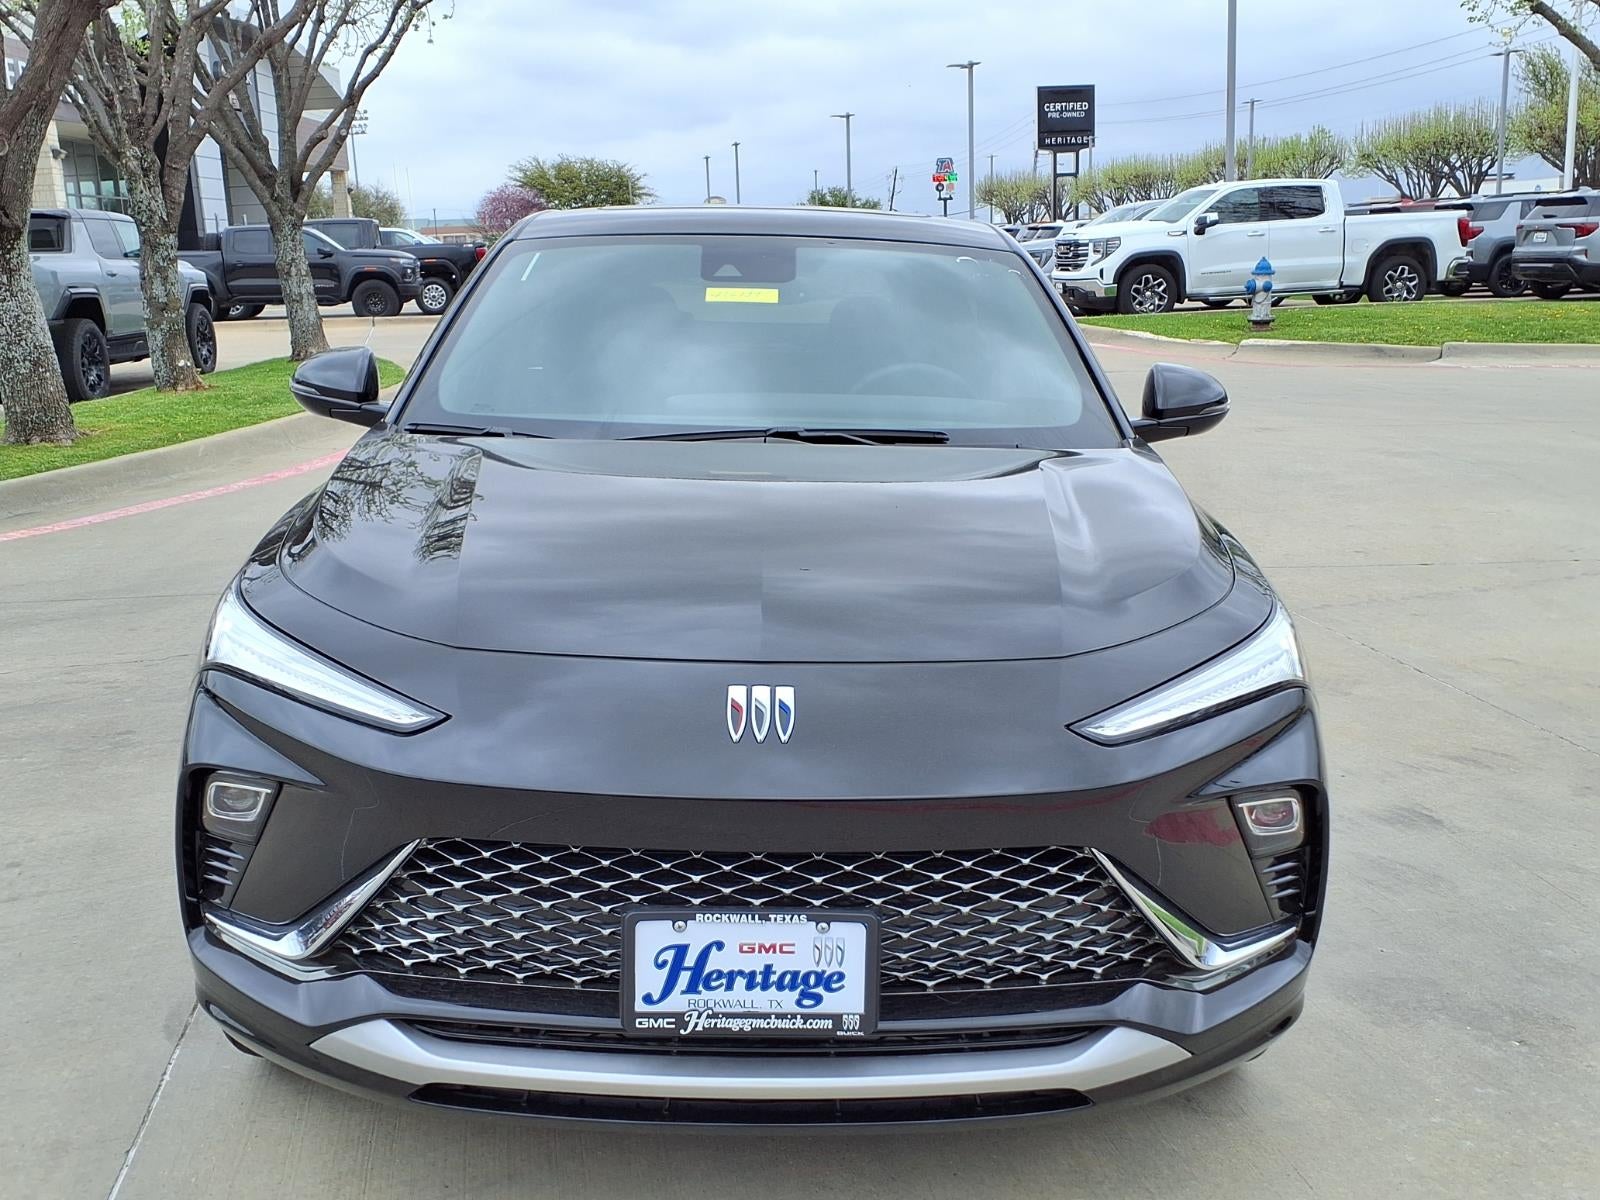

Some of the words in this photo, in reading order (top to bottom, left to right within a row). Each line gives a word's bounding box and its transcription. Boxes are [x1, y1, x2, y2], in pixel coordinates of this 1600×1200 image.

[1044, 102, 1089, 112] CERTIFIED
[1047, 111, 1086, 119] PRE-OWNED
[1045, 135, 1089, 145] HERITAGE
[768, 913, 808, 925] TEXAS
[738, 942, 797, 955] GMC
[641, 939, 847, 1010] Heritage
[768, 998, 784, 1009] TX
[635, 1017, 677, 1029] GMC
[679, 1007, 834, 1035] Heritagegmcbuick.com
